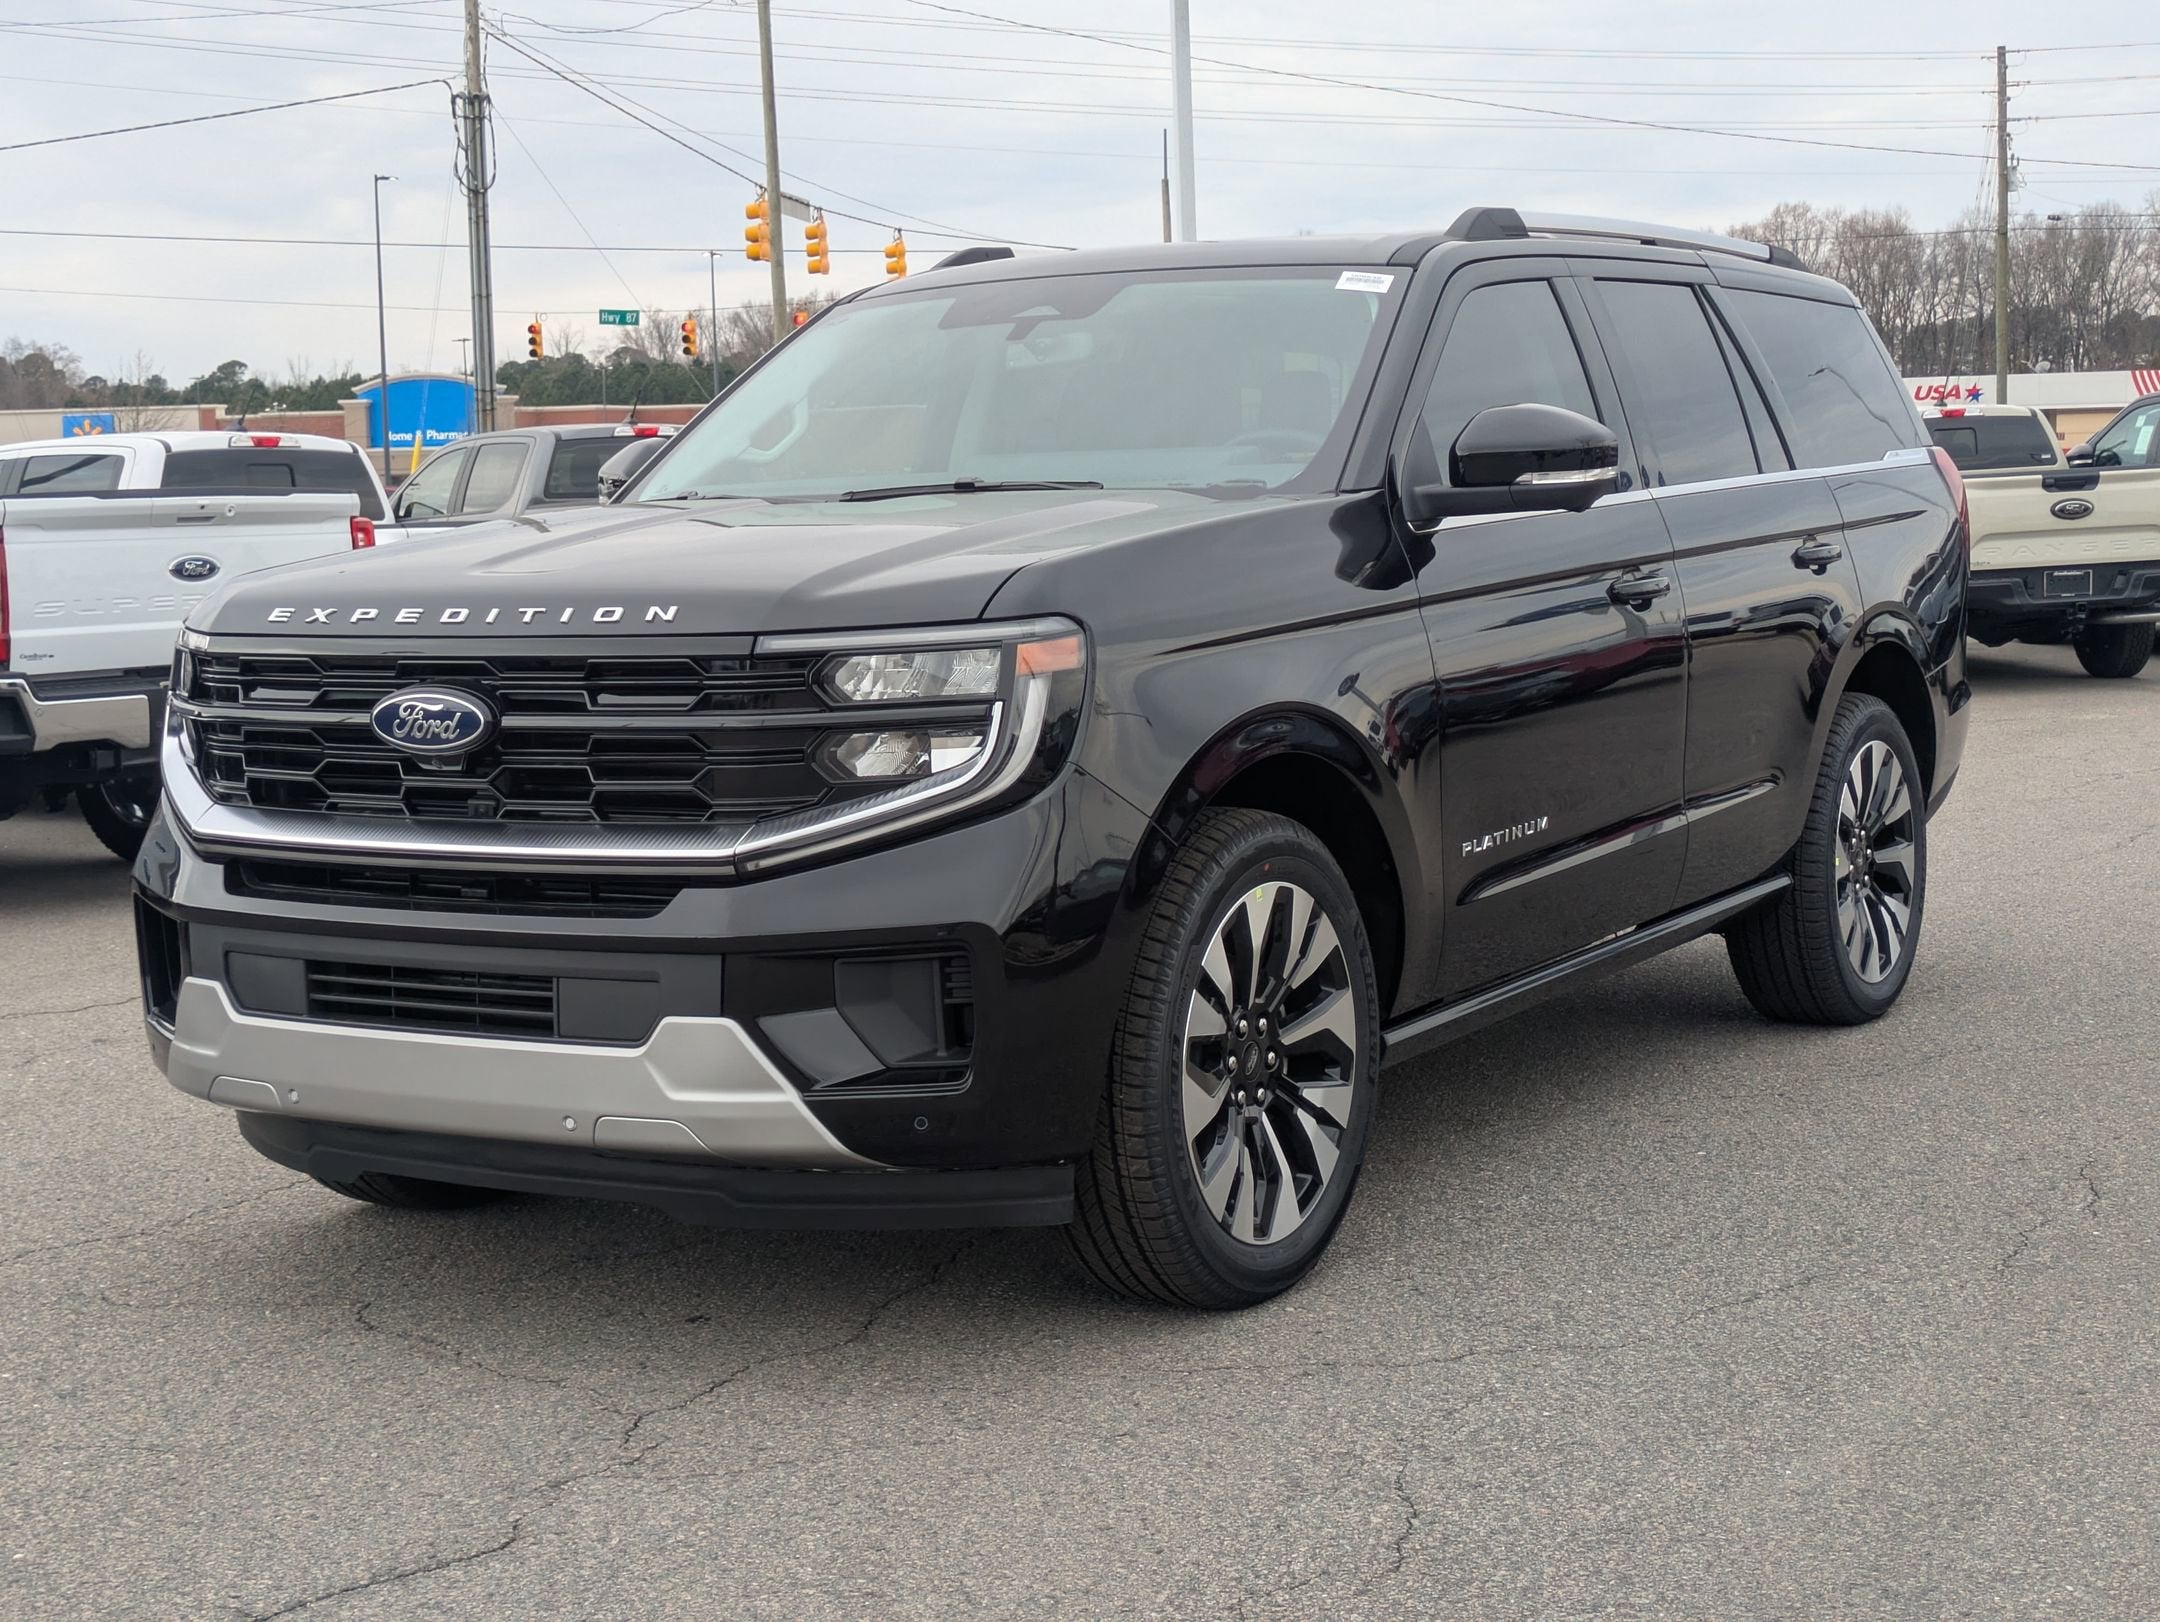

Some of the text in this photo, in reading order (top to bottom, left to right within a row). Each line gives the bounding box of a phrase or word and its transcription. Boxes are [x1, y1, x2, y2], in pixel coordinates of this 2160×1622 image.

[601, 311, 637, 324] Hwy 87
[1914, 384, 1961, 401] USA
[182, 560, 209, 576] Ford
[267, 605, 679, 624] EXPEDITION
[393, 702, 462, 739] Ford
[1462, 816, 1549, 857] PLATINUM
